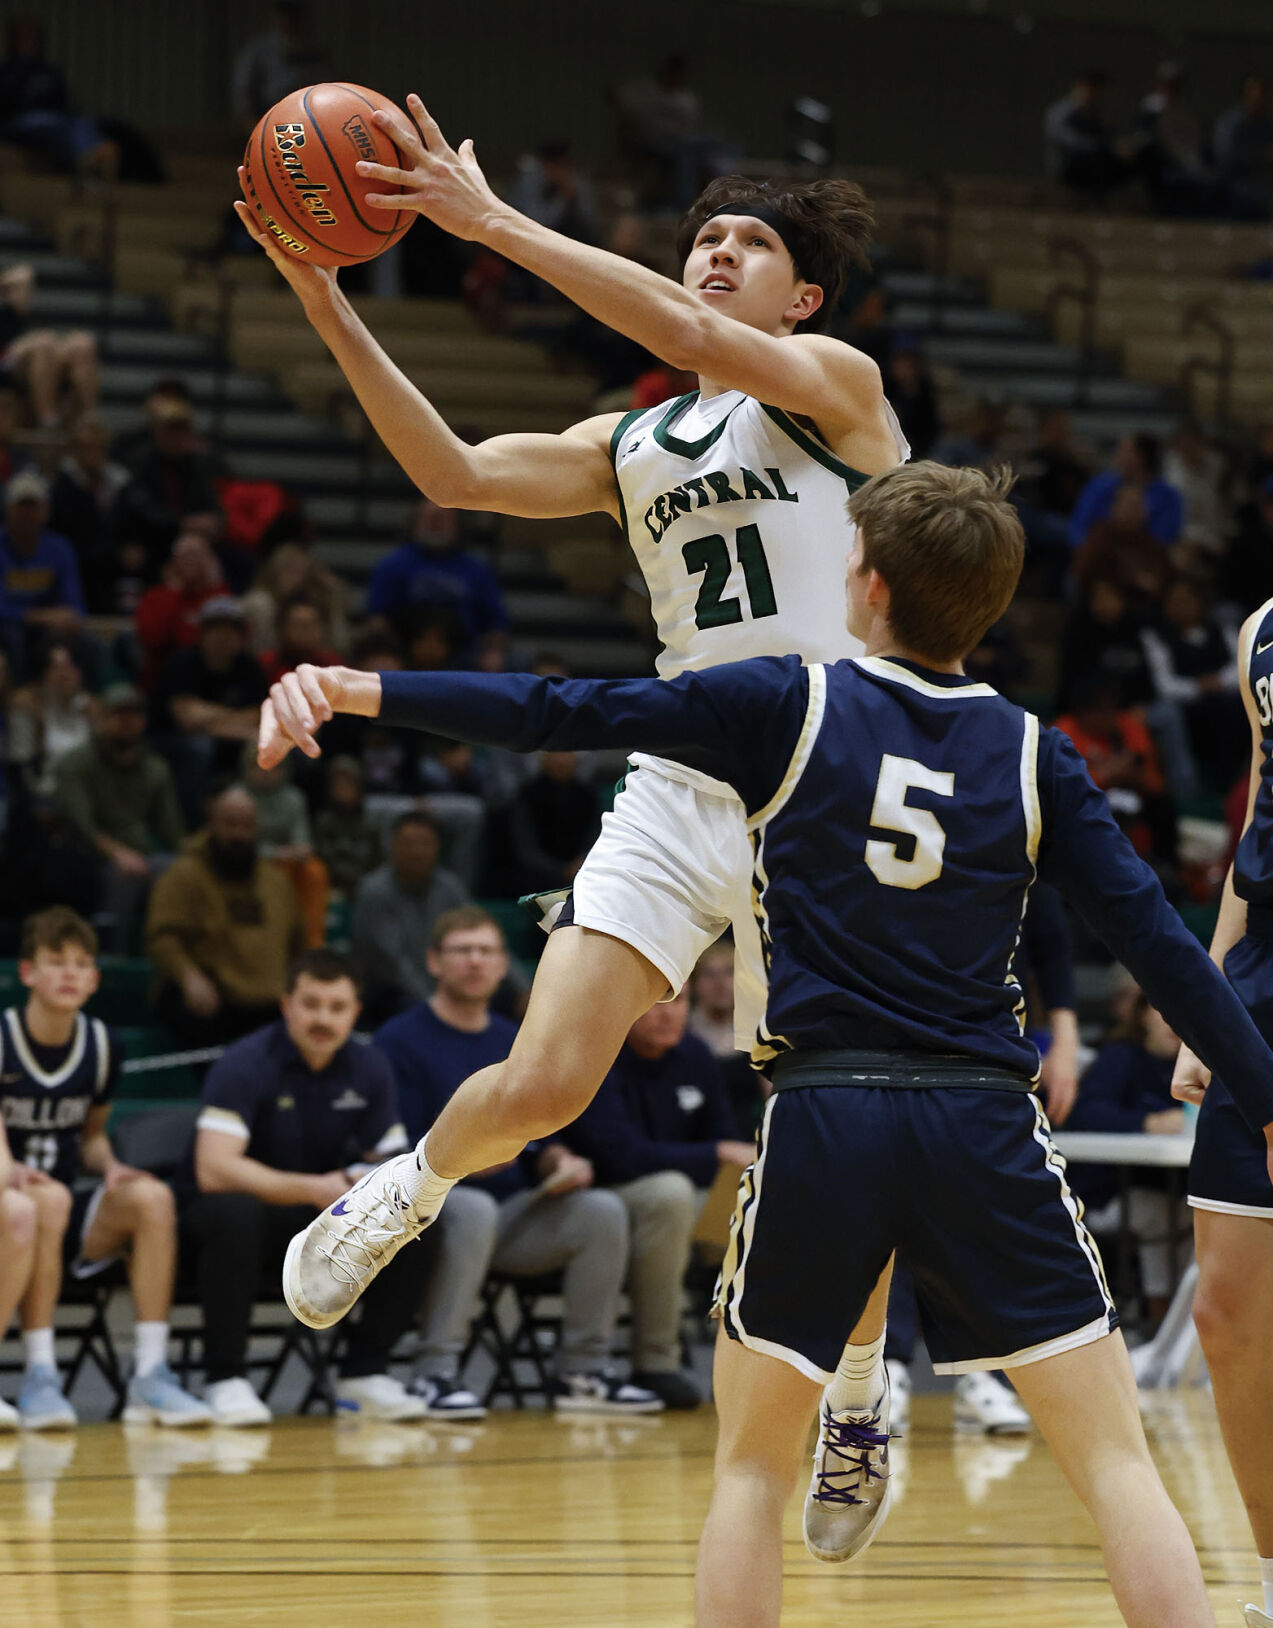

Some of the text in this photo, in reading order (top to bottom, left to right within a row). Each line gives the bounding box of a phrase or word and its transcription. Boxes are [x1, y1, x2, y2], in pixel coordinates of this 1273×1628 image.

[273, 123, 338, 227] Baden
[349, 125, 378, 161] MHS
[269, 220, 308, 254] PRO
[644, 467, 799, 543] CENTRAL
[681, 523, 778, 631] 21
[864, 753, 955, 890] 5
